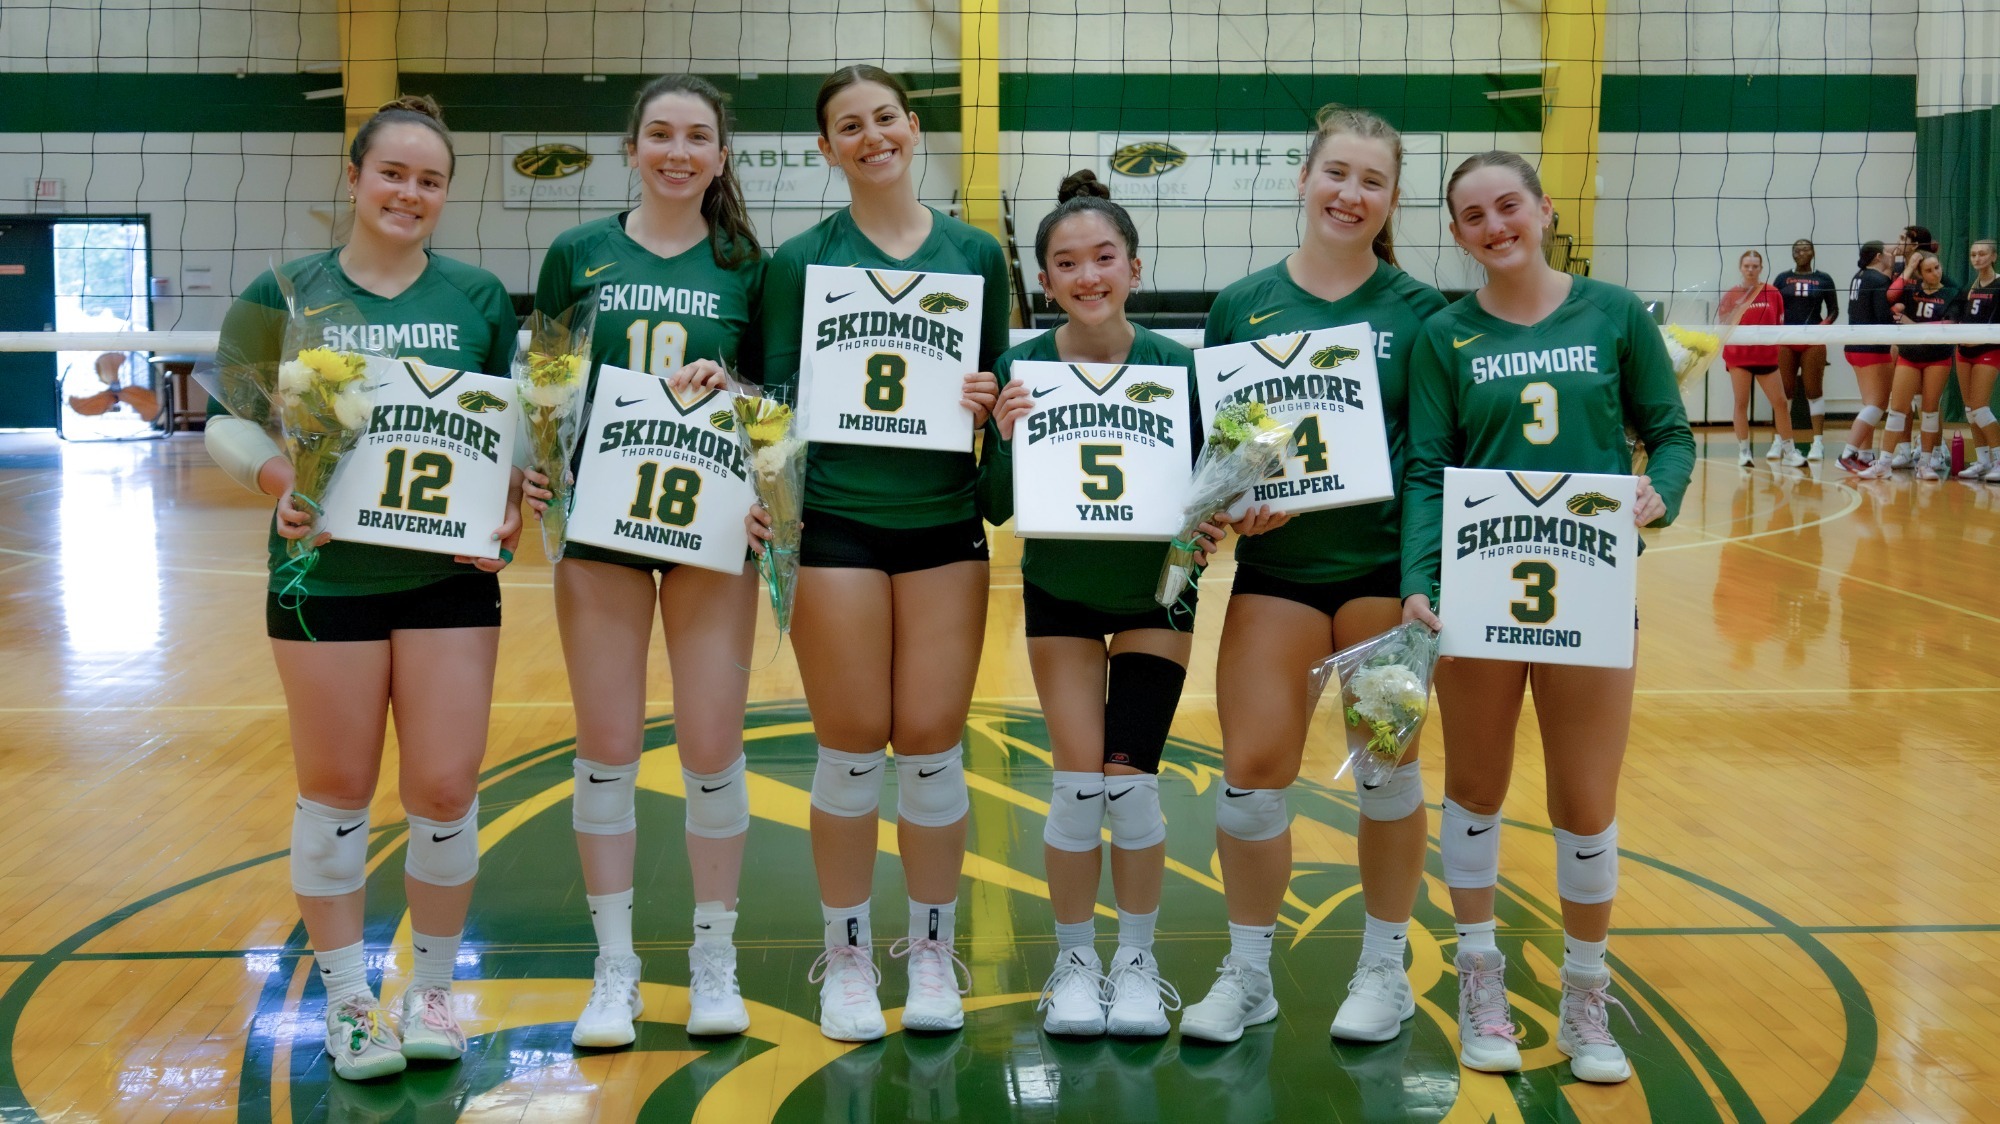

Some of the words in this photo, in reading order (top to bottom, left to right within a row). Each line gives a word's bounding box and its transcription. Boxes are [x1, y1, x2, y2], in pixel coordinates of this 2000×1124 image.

[735, 149, 821, 167] ABLE
[1210, 148, 1272, 166] THE
[510, 184, 595, 197] SKDMORE
[1112, 183, 1188, 195] KIDMORE
[1233, 177, 1298, 191] STUDEN
[600, 284, 720, 319] SKIDMORE
[1794, 282, 1809, 297] 11
[1916, 301, 1934, 318] 16
[1971, 299, 1981, 315] 5
[323, 323, 460, 351] SKIDMORE
[626, 319, 688, 378] 18
[816, 311, 964, 362] SKIDMORE
[838, 339, 943, 361] THOROUGHBREDS
[1472, 345, 1598, 384] SKIDMORE
[862, 351, 908, 414] 8
[839, 413, 928, 435] IMBURGIA
[1028, 403, 1175, 448] SKIDMORE
[1521, 382, 1559, 445] 3
[366, 405, 501, 464] KIDMORE
[369, 434, 478, 461] THOROUGHBREDS
[1051, 429, 1156, 448] THOROUGHBREDS
[599, 419, 747, 482] SKIDMORE
[622, 448, 728, 478] THOROUGHBREDS
[379, 446, 455, 516] 12
[1079, 443, 1126, 502] 5
[628, 460, 704, 528] 18
[1253, 474, 1345, 501] HOELPERL
[358, 509, 467, 539] BRAVERMAN
[1076, 505, 1133, 521] YANG
[614, 519, 703, 551] MANNING
[1457, 515, 1617, 568] SKIDMORE
[1480, 545, 1595, 567] THOROUGHBREDS
[1509, 559, 1558, 625] 3
[1485, 625, 1582, 647] FERRIGNO
